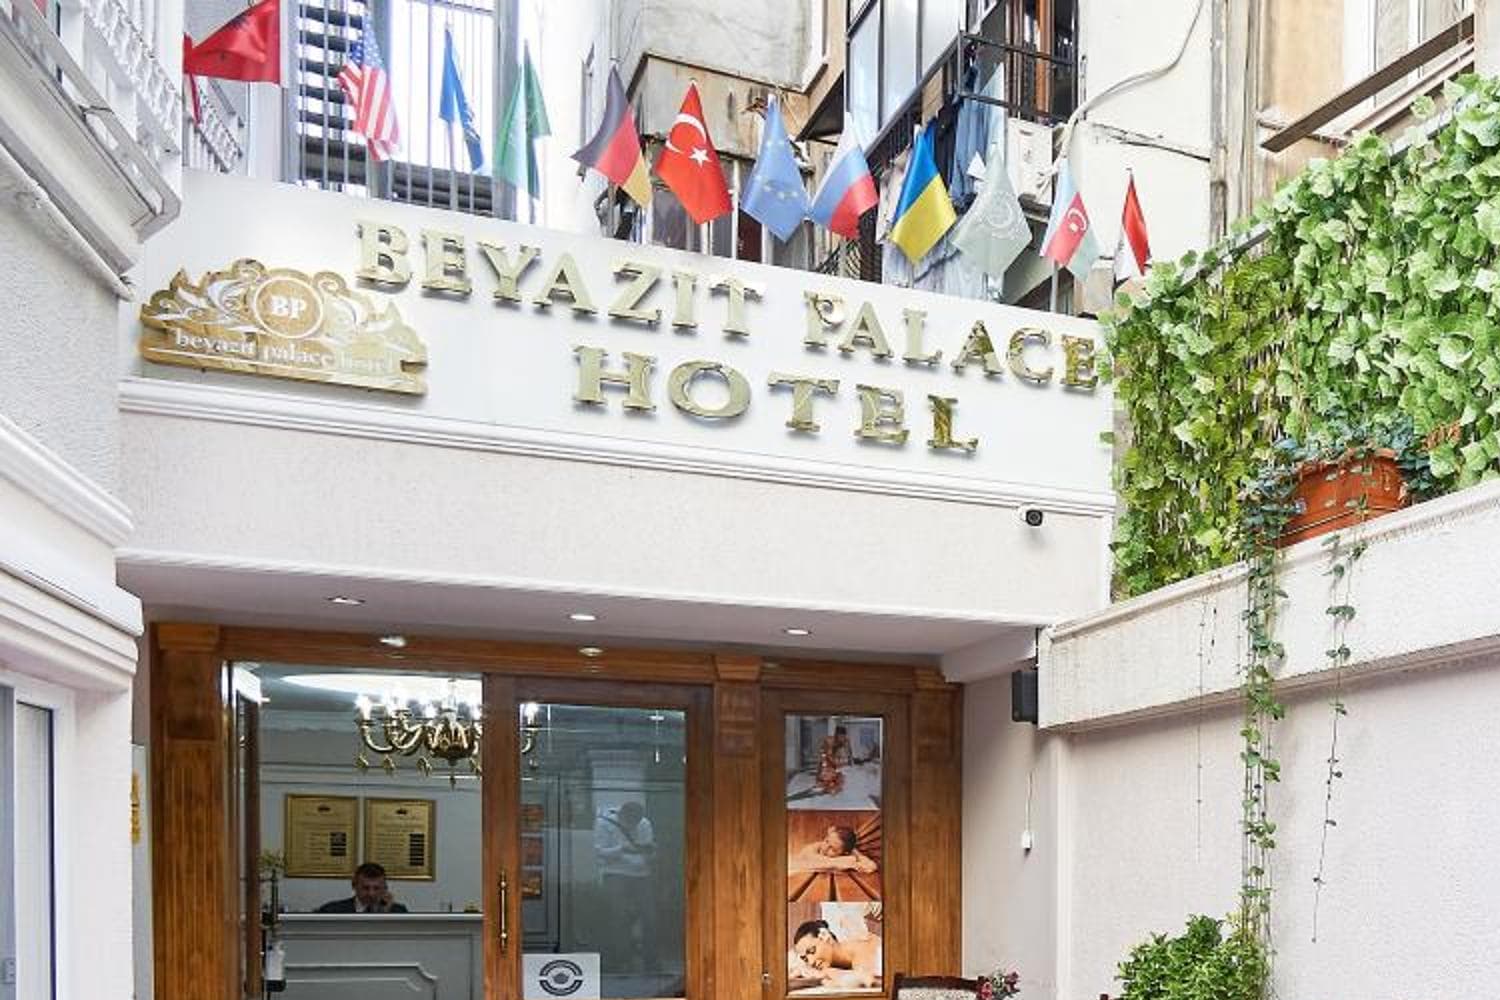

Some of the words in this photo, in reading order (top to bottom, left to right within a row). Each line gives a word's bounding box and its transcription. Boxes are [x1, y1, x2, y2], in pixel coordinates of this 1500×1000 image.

[270, 295, 307, 320] BP
[356, 222, 767, 336] BEYAZIT
[804, 290, 1098, 390] PALACE
[572, 344, 980, 452] HOTEL
